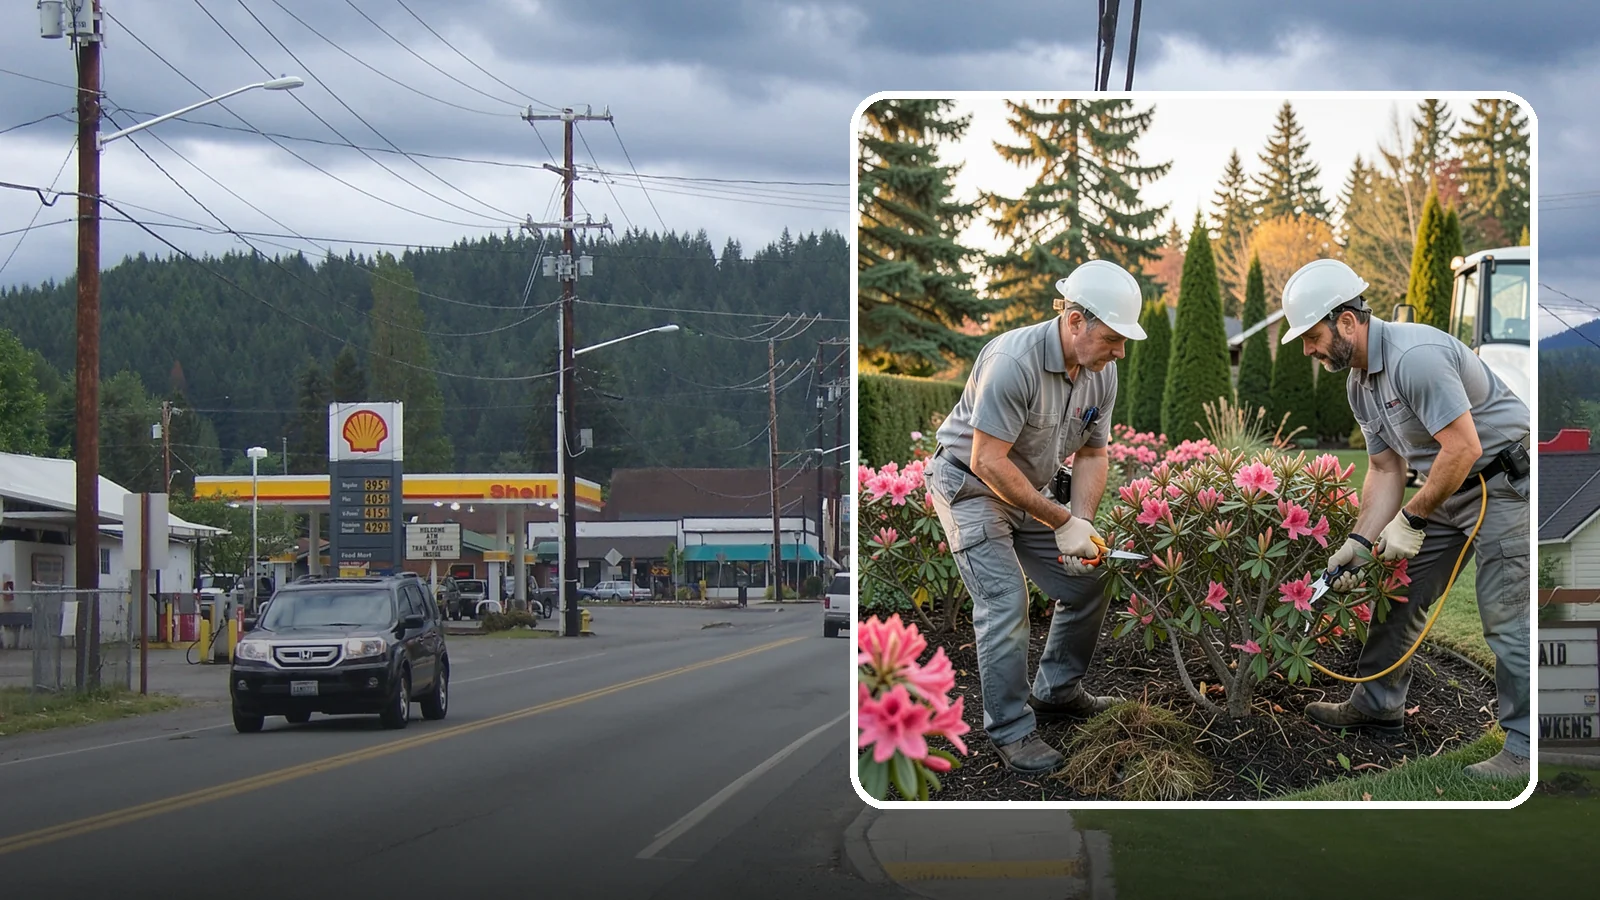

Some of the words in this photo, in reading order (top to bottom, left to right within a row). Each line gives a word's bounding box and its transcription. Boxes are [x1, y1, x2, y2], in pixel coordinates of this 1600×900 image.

[366, 480, 383, 490] 395
[490, 484, 547, 499] Shell
[366, 494, 383, 504] 405
[366, 508, 383, 518] 415
[366, 522, 383, 532] 429
[1538, 643, 1567, 665] AID
[1538, 716, 1592, 738] WKENS
